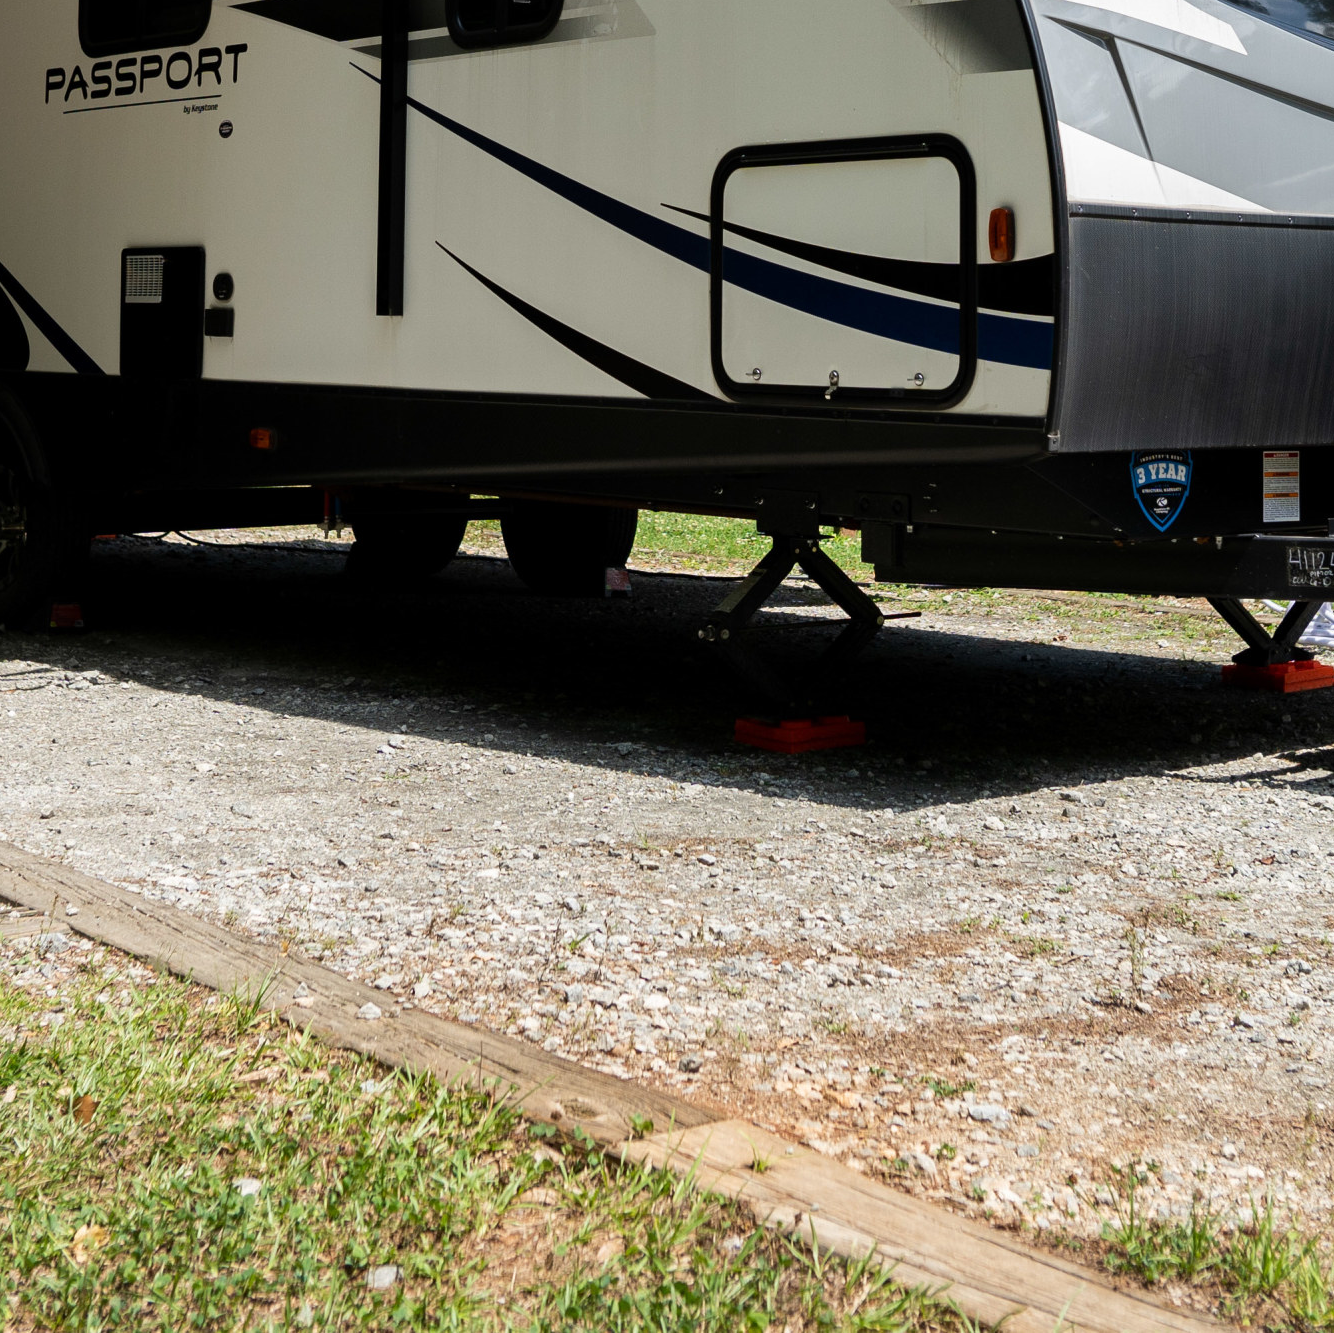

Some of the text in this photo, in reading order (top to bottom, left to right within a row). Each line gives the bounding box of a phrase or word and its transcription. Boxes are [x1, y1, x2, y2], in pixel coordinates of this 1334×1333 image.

[45, 43, 248, 104] PASSPORT
[183, 103, 219, 114] by Keystone
[1136, 462, 1186, 484] 3 YEAR
